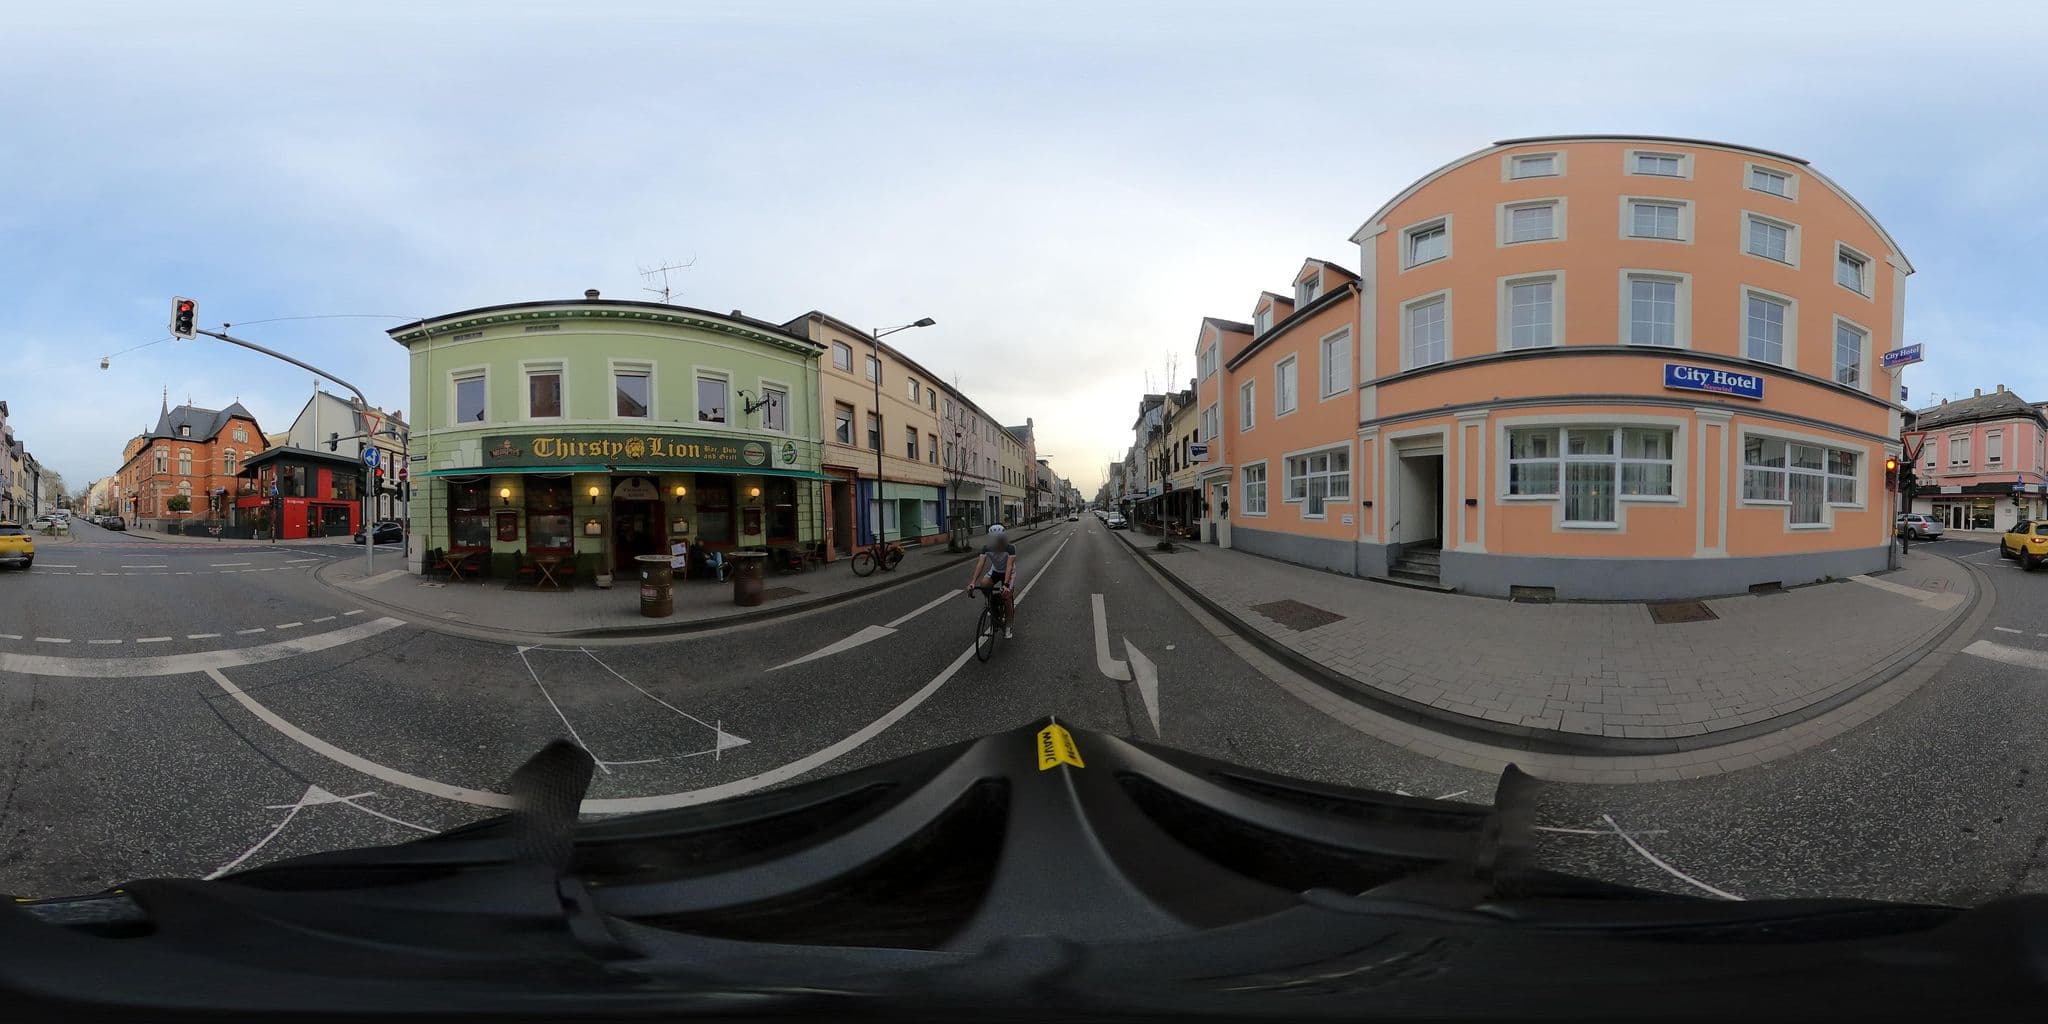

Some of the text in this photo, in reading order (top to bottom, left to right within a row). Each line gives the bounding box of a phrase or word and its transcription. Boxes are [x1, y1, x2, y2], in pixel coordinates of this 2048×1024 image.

[1885, 352, 1899, 361] City
[1900, 346, 1919, 357] Hotel
[1674, 366, 1756, 389] City Hotel
[532, 437, 700, 459] Thirsty Lion
[1042, 732, 1056, 763] MAVIC
